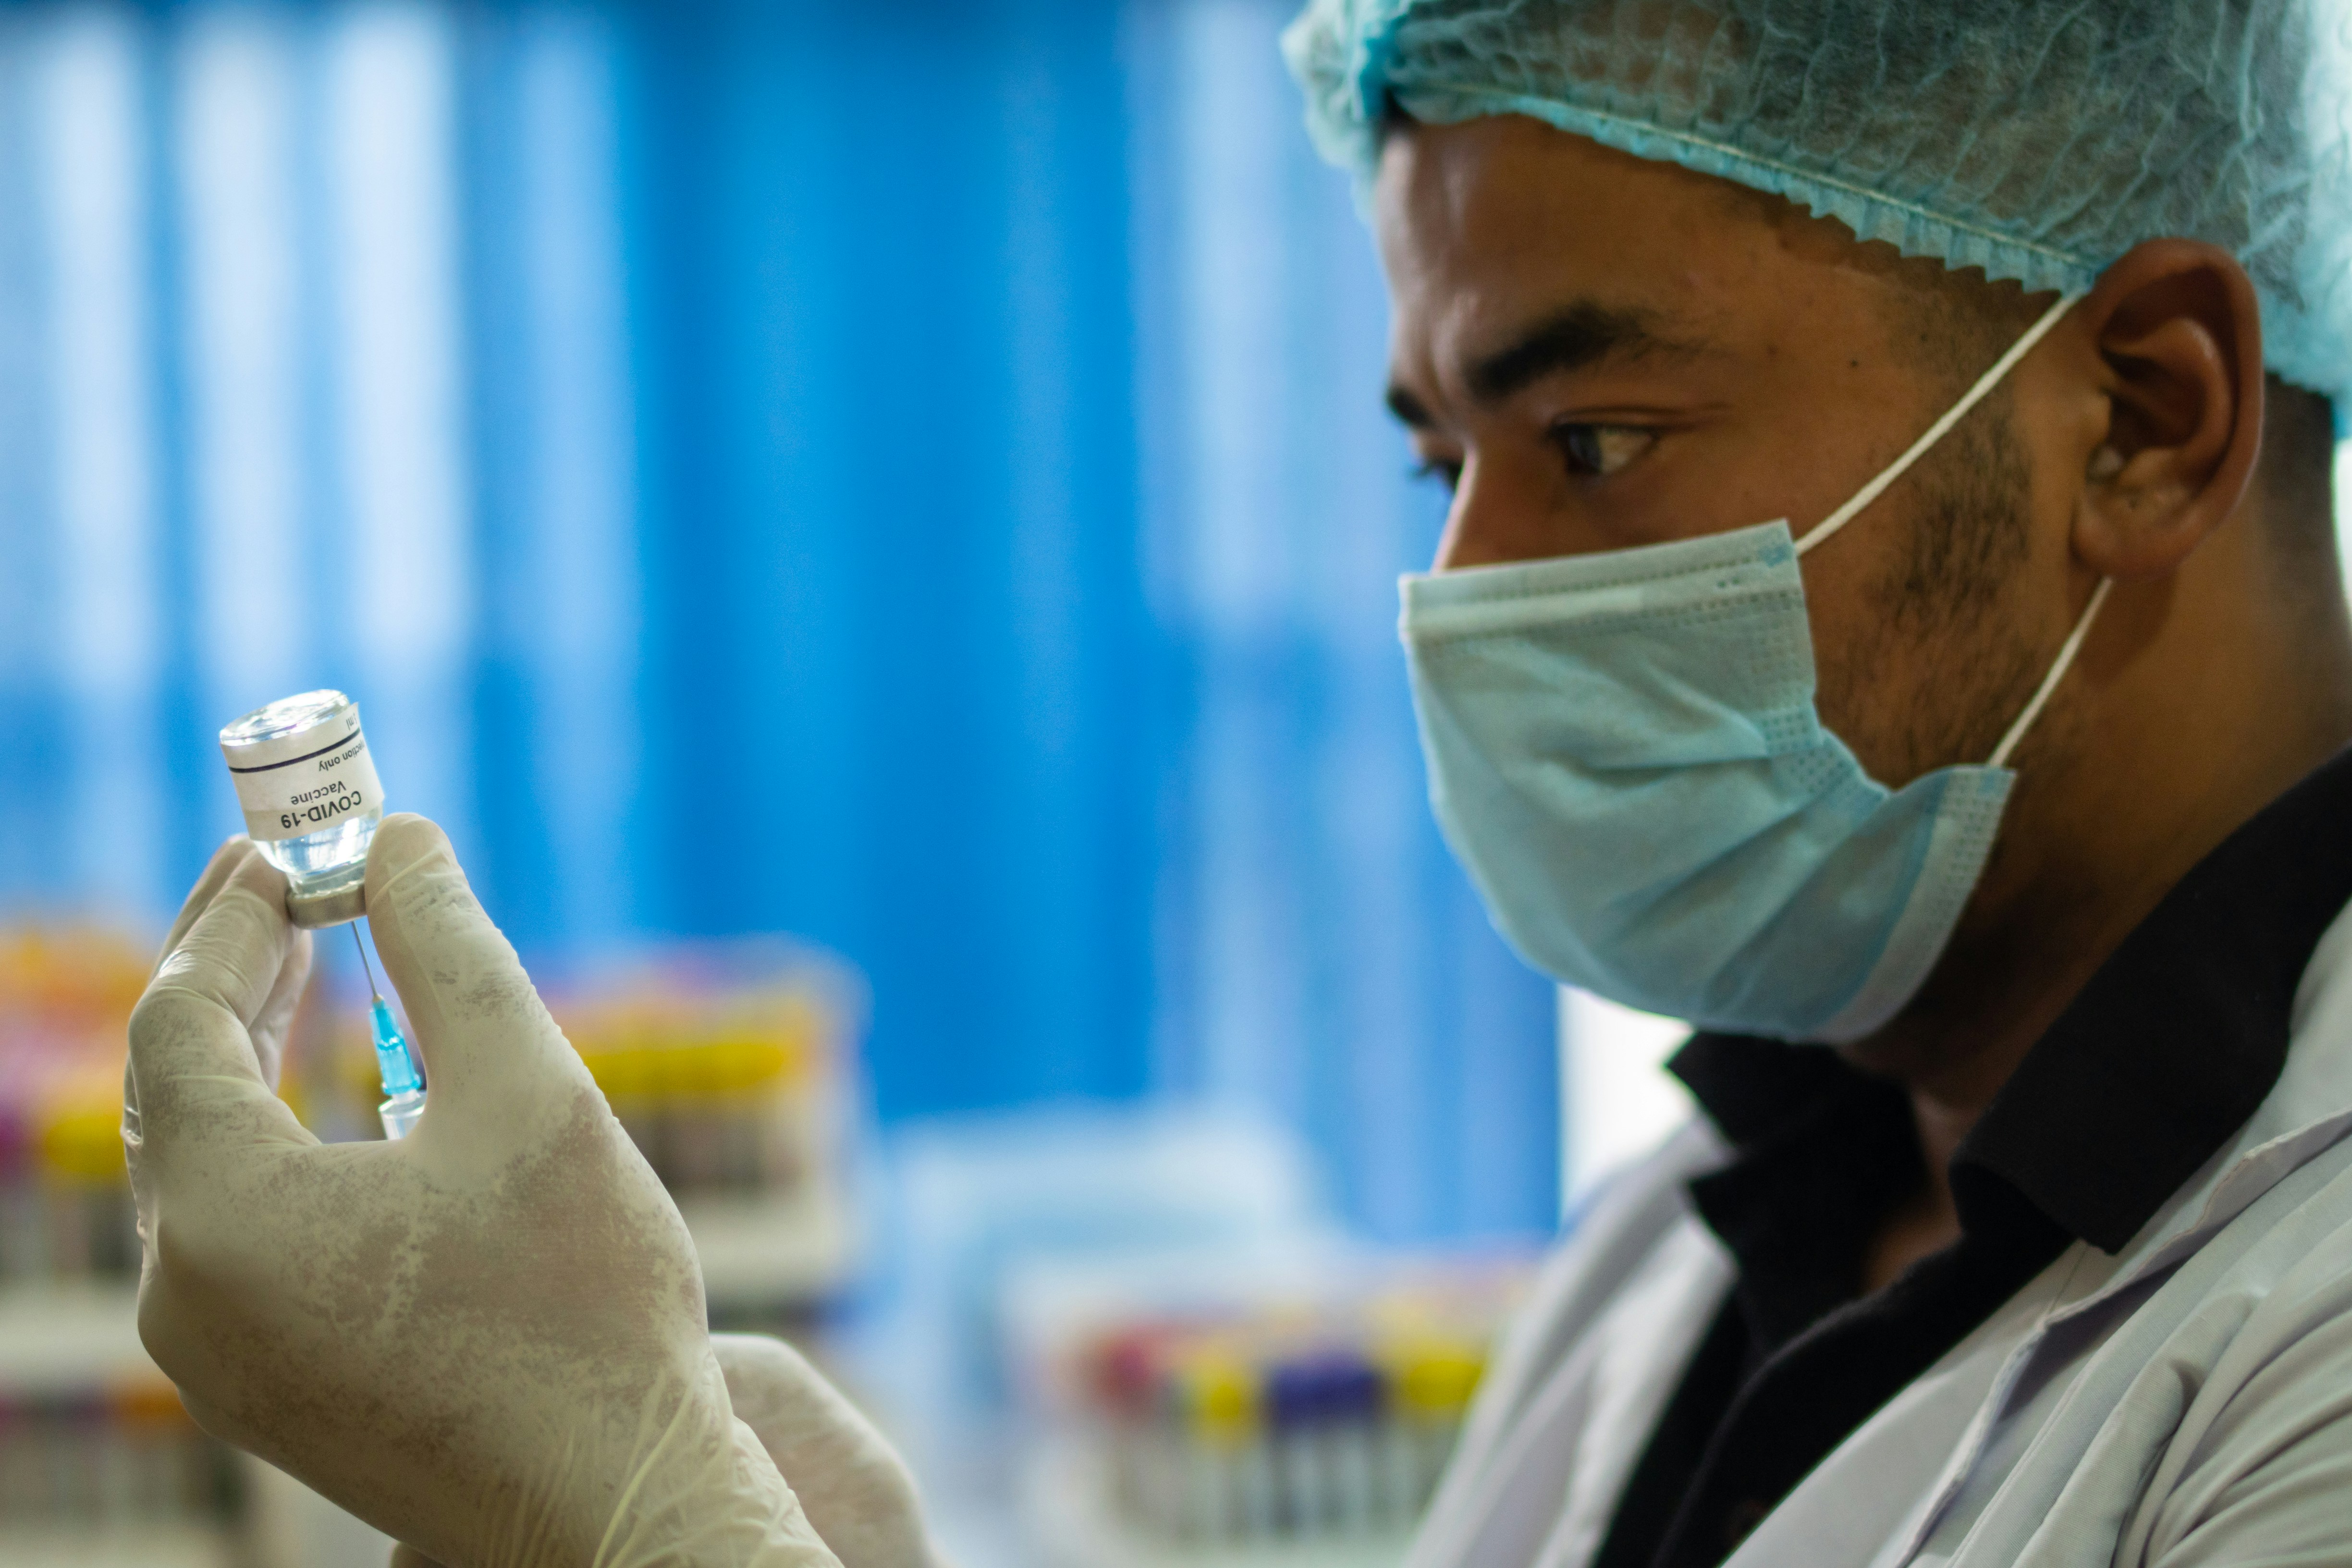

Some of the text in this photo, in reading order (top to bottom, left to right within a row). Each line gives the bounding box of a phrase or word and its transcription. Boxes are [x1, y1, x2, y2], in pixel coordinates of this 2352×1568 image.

[318, 757, 341, 772] only
[290, 781, 347, 805] Vaccine
[281, 791, 362, 829] COVID-19
